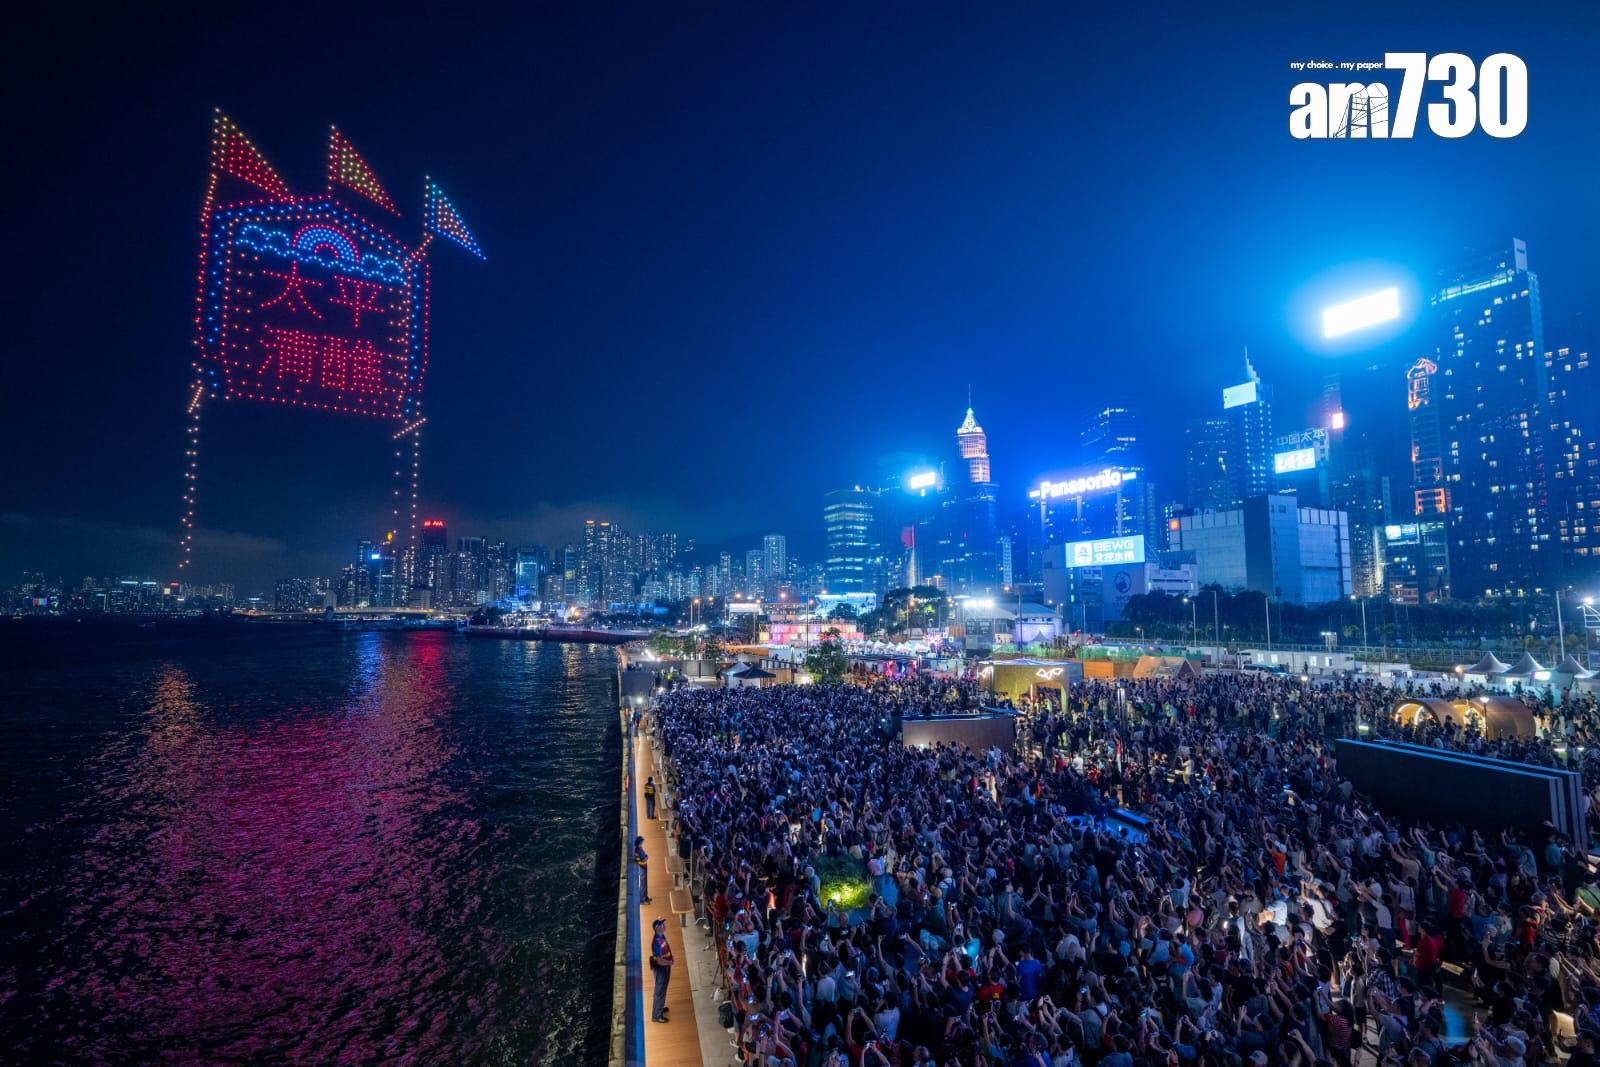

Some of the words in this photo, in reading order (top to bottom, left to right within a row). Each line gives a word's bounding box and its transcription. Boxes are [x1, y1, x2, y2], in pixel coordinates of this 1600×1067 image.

[260, 261, 385, 327] 太平
[1040, 469, 1121, 499] Panasonic
[1094, 540, 1134, 552] BEWG
